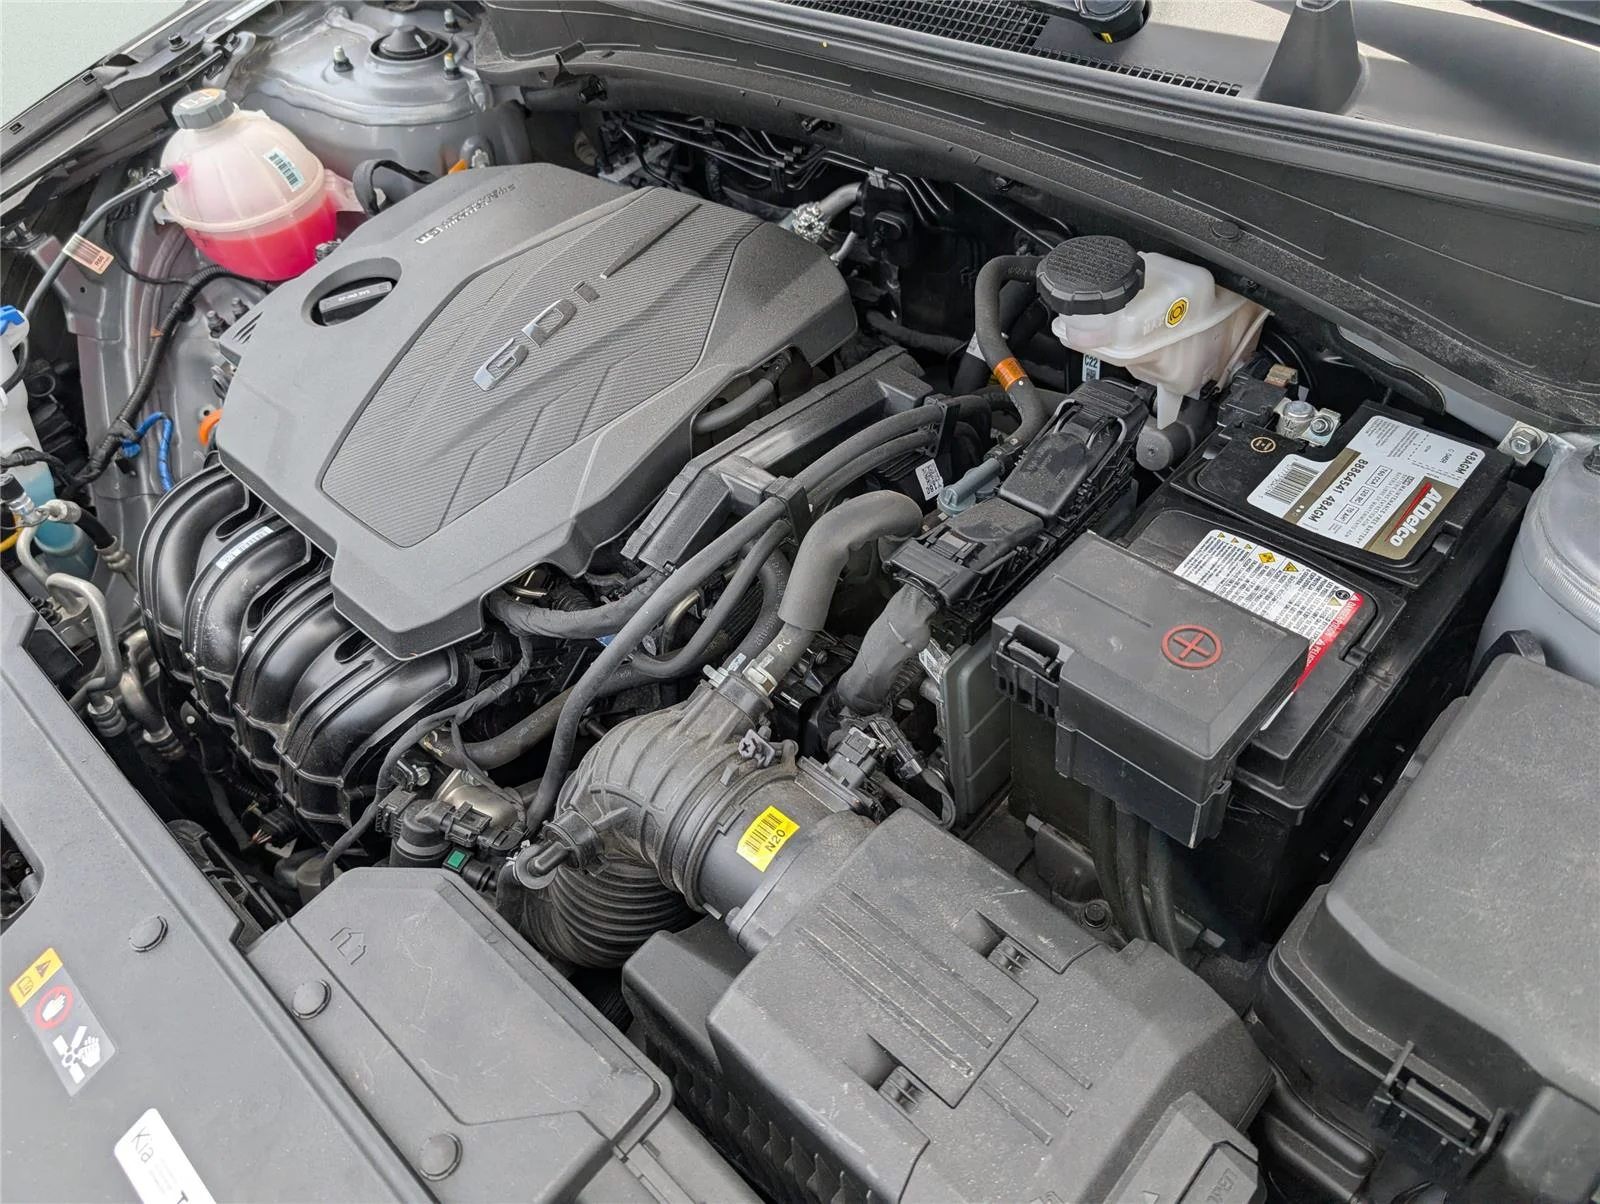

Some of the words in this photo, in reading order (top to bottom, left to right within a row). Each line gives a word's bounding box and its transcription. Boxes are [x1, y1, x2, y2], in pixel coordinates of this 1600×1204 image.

[1084, 354, 1099, 369] C22
[1333, 458, 1369, 494] 88864541
[1455, 451, 1479, 475] 48AGM
[1308, 495, 1336, 522] 48AGM
[1389, 487, 1443, 548] ACDelco
[765, 829, 786, 852] N20
[131, 1126, 154, 1163] Kia
